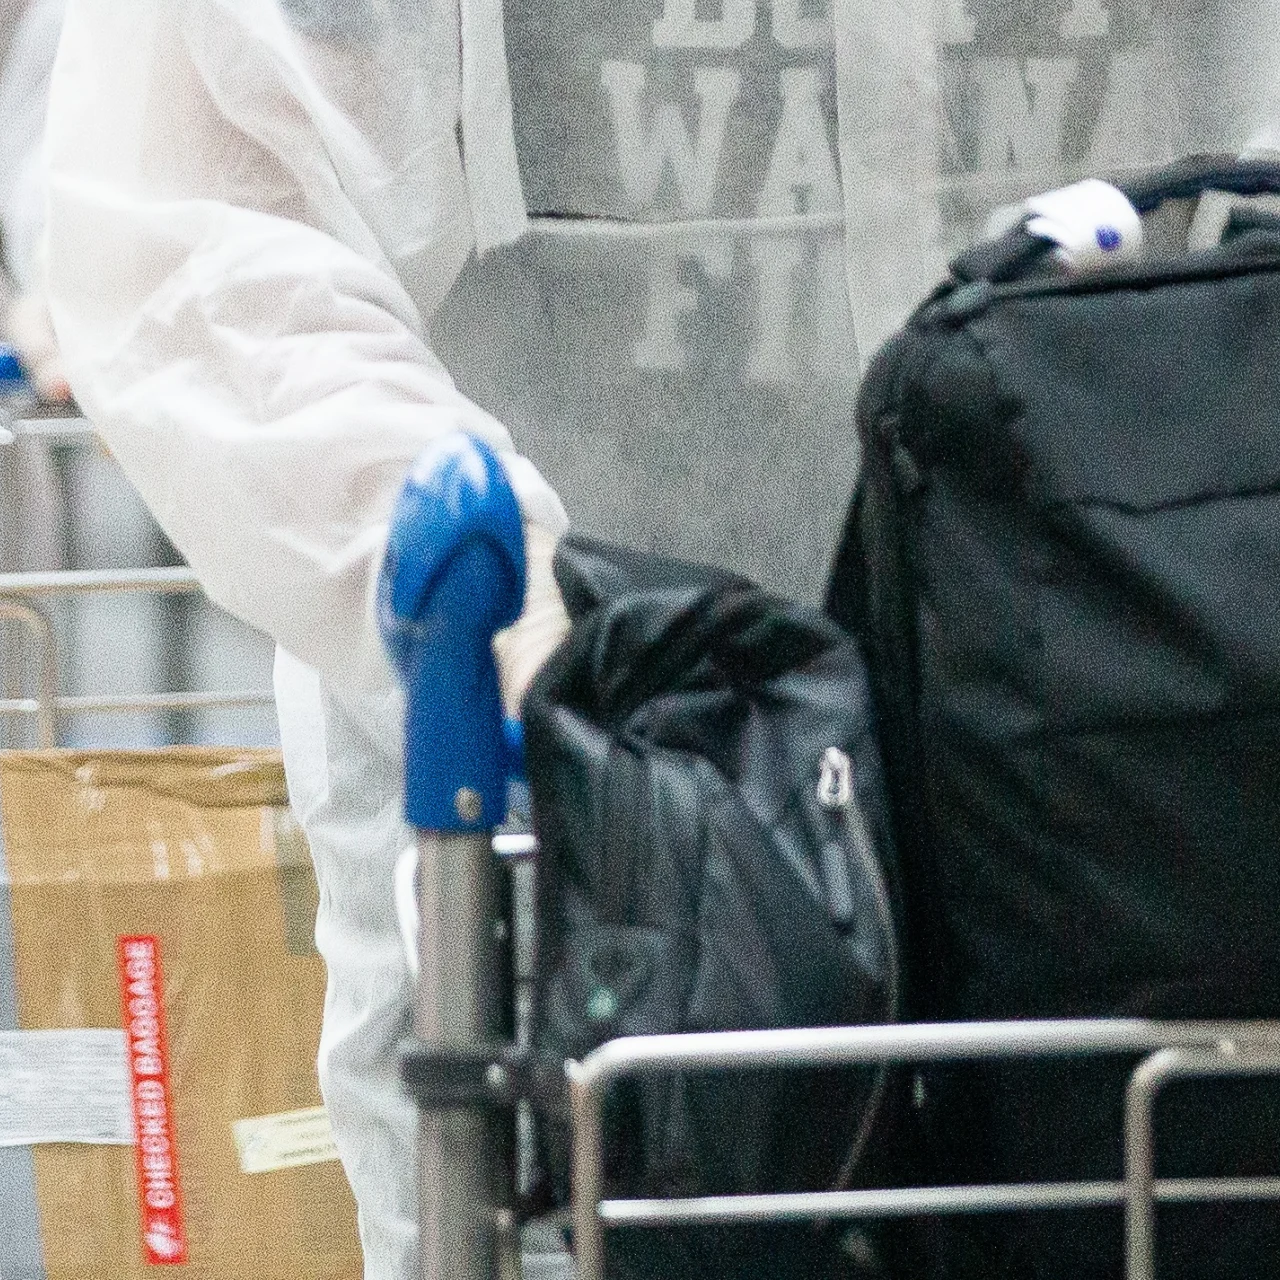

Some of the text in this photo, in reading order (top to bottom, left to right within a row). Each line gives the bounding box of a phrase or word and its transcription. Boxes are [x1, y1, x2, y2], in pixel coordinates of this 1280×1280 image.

[601, 54, 1188, 216] WANA
[125, 940, 175, 1210] CHECKED BAGGAGE
